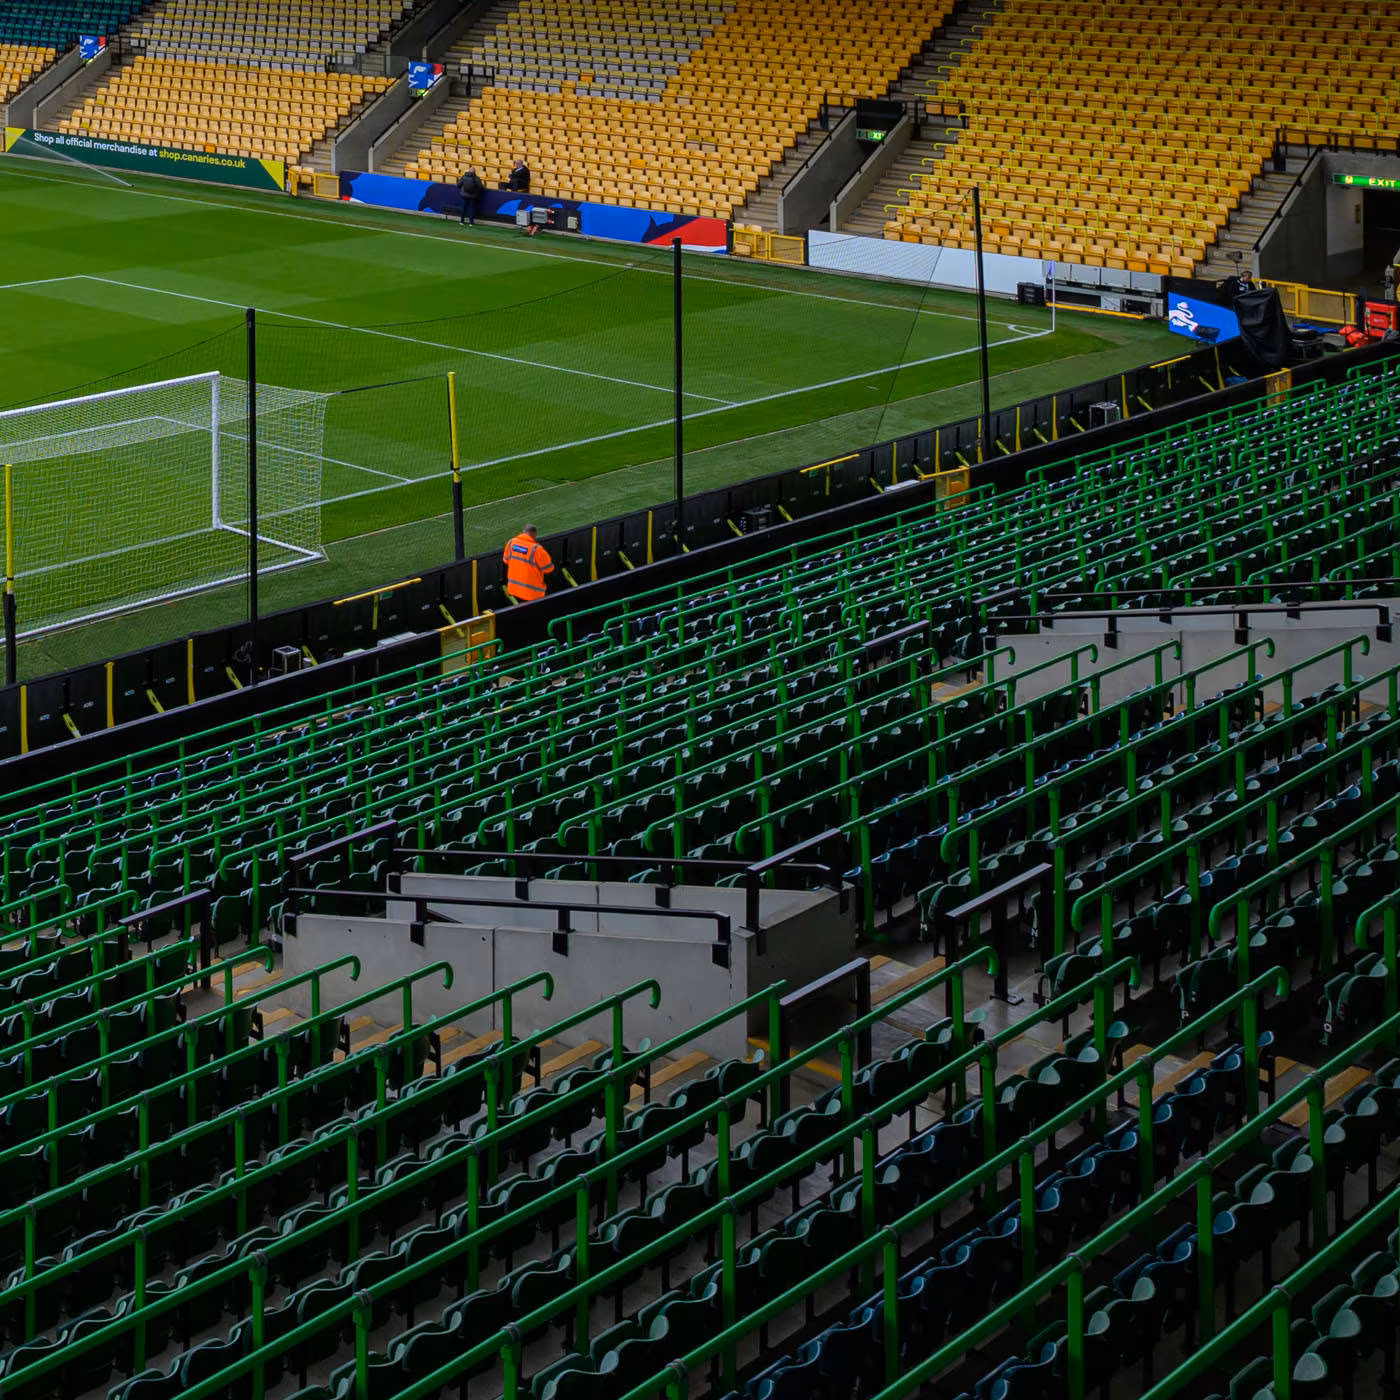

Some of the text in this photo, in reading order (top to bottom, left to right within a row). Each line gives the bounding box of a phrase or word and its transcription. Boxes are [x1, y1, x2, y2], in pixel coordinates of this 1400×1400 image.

[34, 132, 246, 168] Shop all official merchandise at shop.canaries.co.uk
[1368, 177, 1396, 188] EXIT
